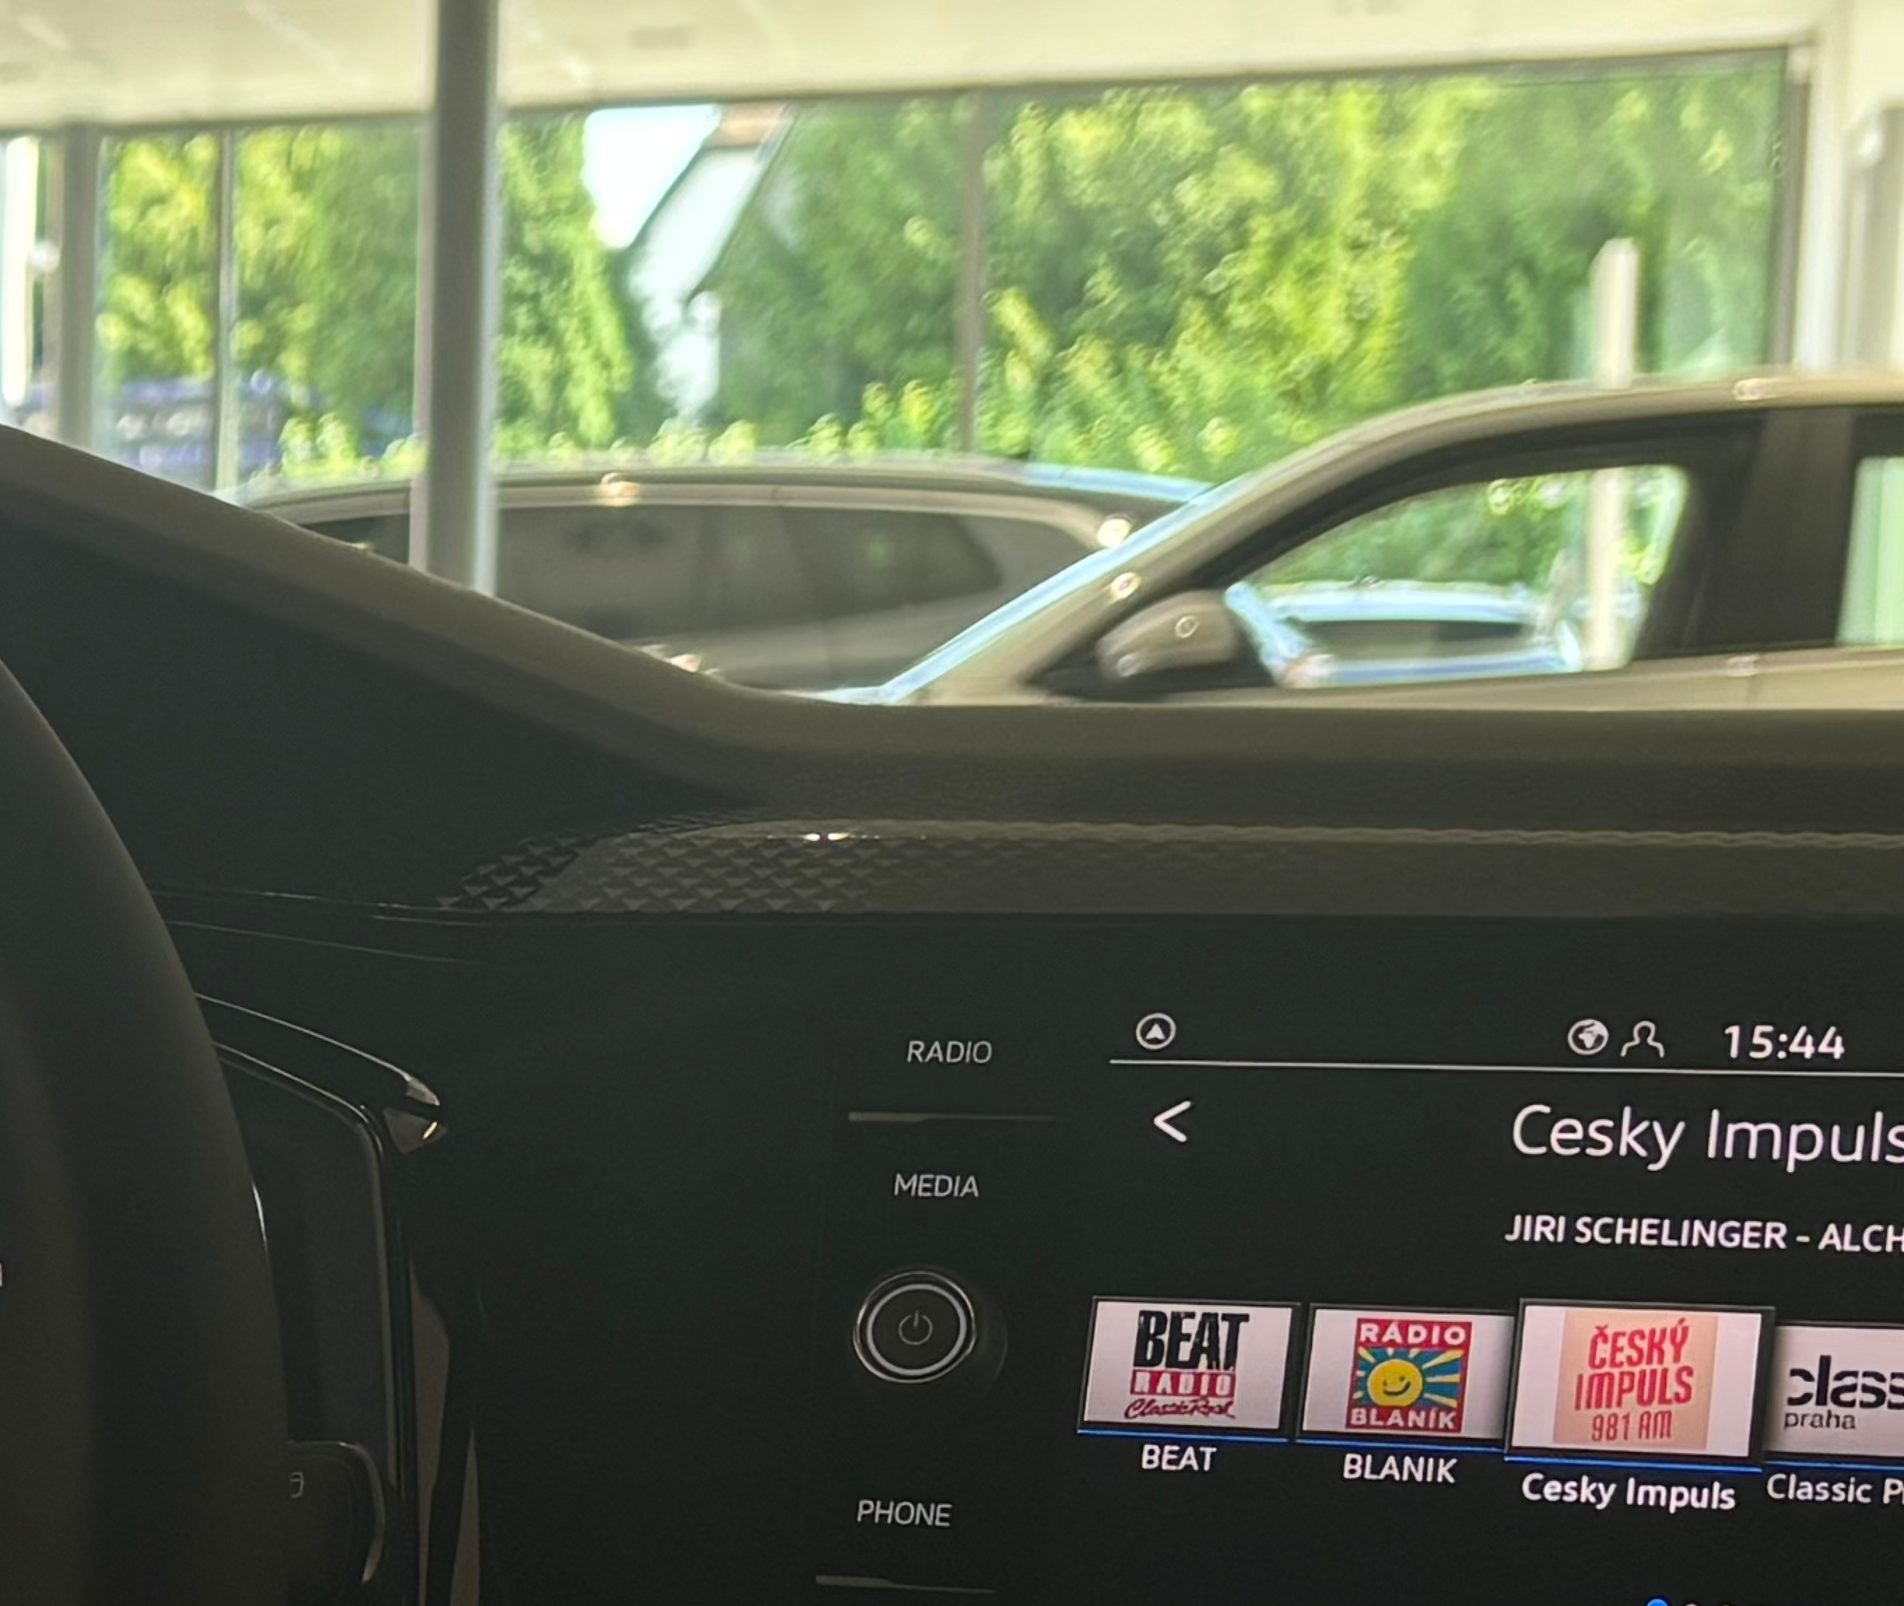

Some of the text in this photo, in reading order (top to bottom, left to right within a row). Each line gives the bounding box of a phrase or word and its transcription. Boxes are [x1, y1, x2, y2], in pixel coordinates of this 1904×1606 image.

[906, 1040, 993, 1064] RADIO
[1724, 1024, 1845, 1060] 15:44
[1513, 1104, 1904, 1173] Cesky Impuls
[894, 1173, 979, 1198] MEDIA
[1504, 1214, 1566, 1243] JIRI
[1574, 1216, 1788, 1249] SCHELINGER
[1818, 1223, 1904, 1253] ALCH
[1133, 1309, 1250, 1370] BEAT
[1587, 1317, 1690, 1370] ČESKÝ
[1135, 1373, 1231, 1396] RADIO
[1574, 1365, 1695, 1411] IMPULS
[1591, 1410, 1672, 1441] 981 AM
[1784, 1409, 1856, 1430] praha
[1141, 1443, 1218, 1472] BEAT
[1343, 1453, 1458, 1484] BLANIK
[1521, 1472, 1736, 1514] Cesky Impuls
[1766, 1473, 1904, 1505] Classic P
[857, 1499, 953, 1527] PHONE
